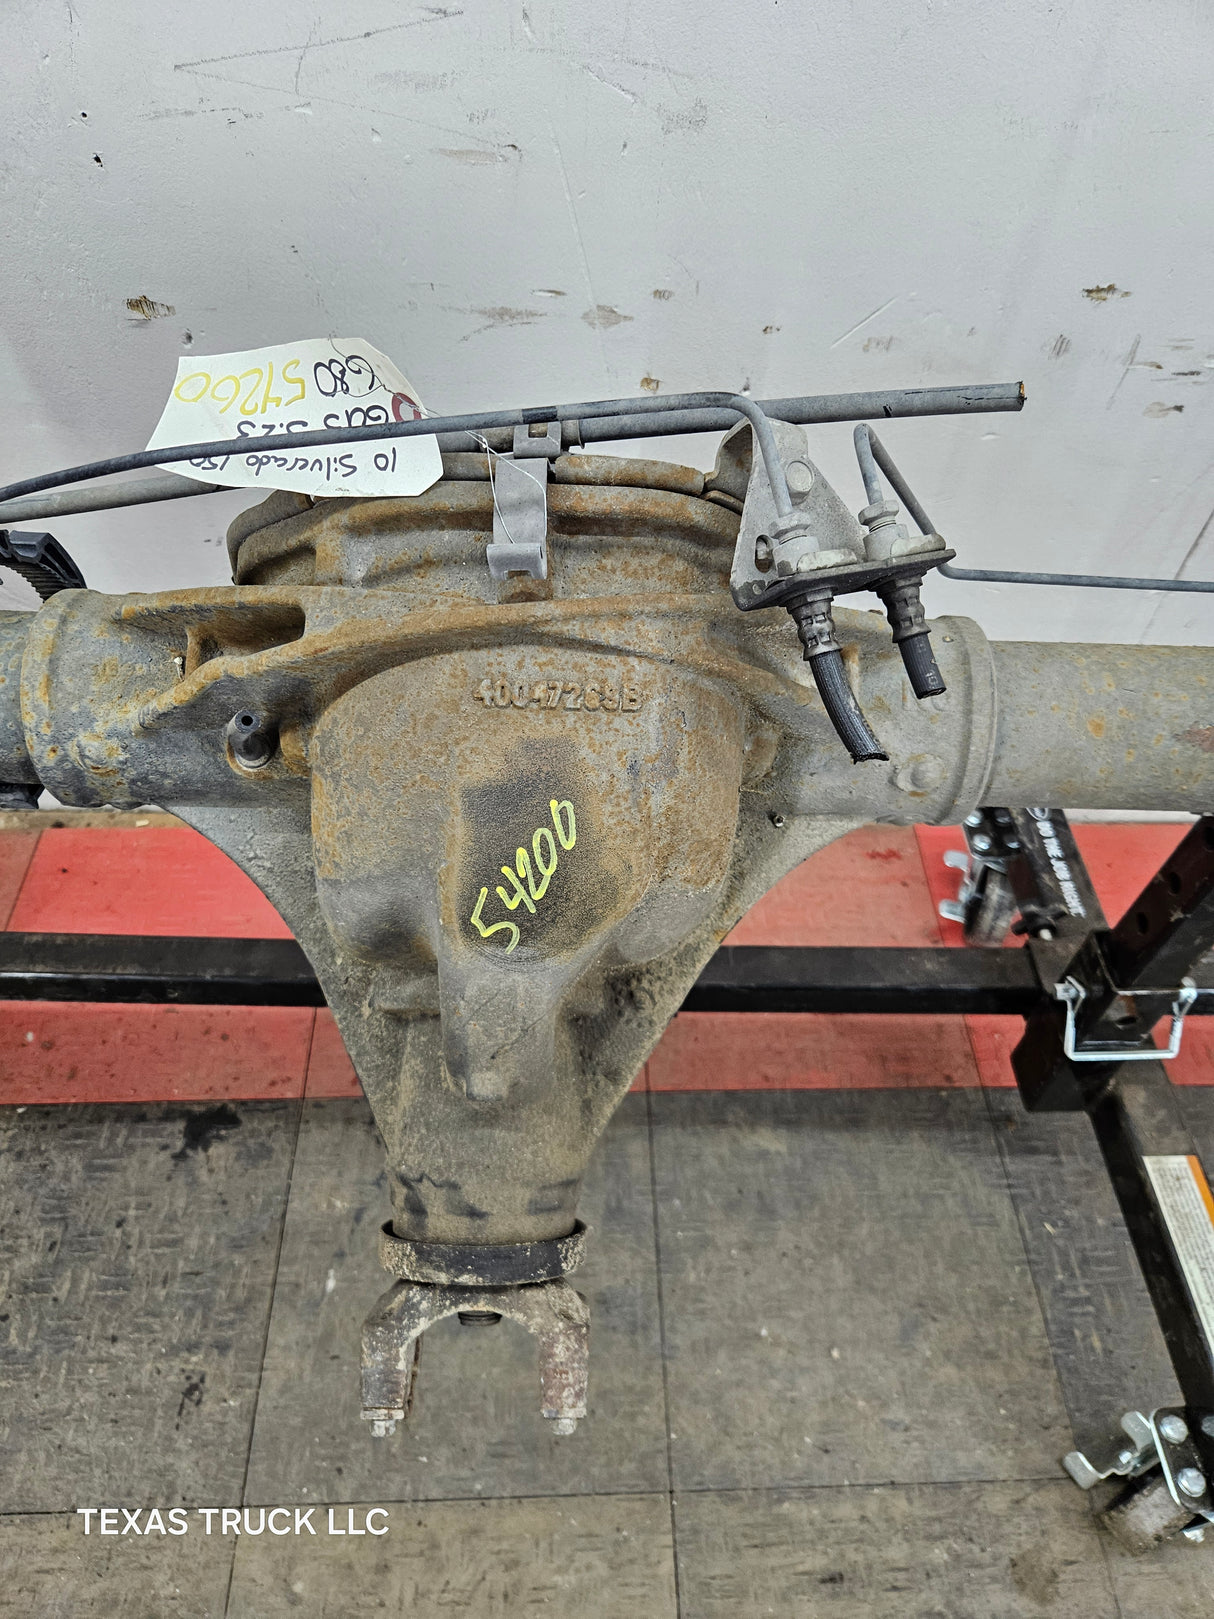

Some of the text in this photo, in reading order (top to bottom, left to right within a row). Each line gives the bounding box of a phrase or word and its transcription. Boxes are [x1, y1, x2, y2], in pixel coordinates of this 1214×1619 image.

[173, 359, 307, 416] 54260
[245, 452, 358, 482] Silverado
[373, 446, 397, 473] 10
